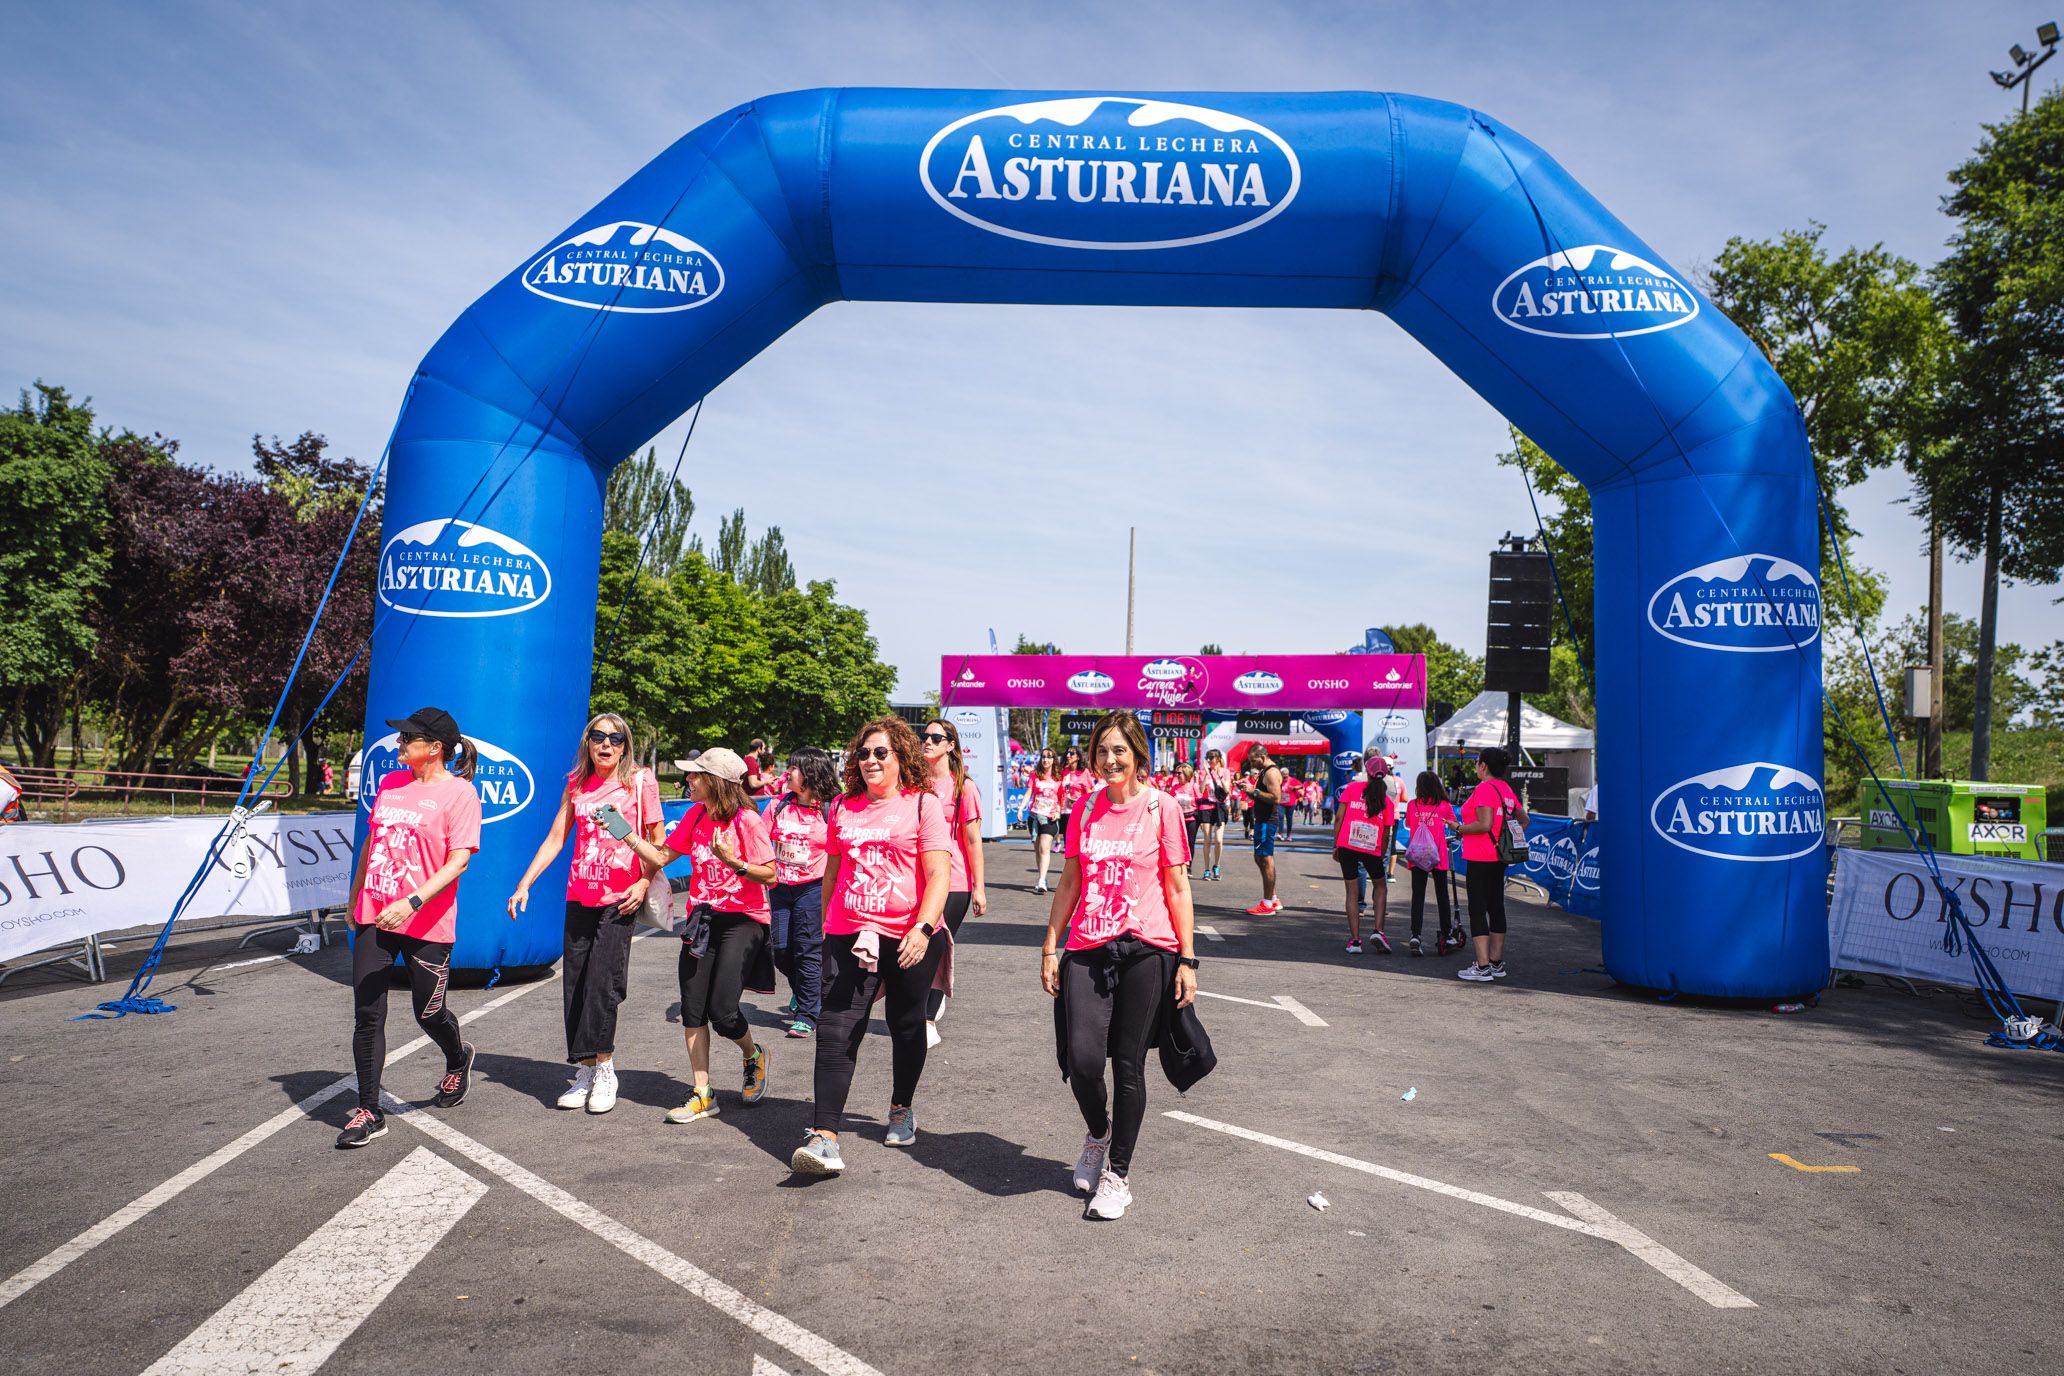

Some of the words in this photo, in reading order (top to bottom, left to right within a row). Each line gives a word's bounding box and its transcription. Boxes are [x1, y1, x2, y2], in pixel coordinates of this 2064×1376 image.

[1008, 133, 1126, 150] CENTRAL
[1139, 136, 1260, 154] LECHERA
[948, 134, 1271, 206] ASTURIANA
[567, 250, 628, 260] CENTRAL
[531, 256, 708, 296] ASTURIANA
[1618, 275, 1677, 290] LECHERA
[1509, 281, 1690, 319] ASTURIANA
[400, 551, 456, 562] CENTRAL
[463, 553, 532, 570] LECHERA
[381, 554, 536, 600] ASTURIANA
[1696, 588, 1766, 599] CENTRAL
[1772, 588, 1816, 600] LECHERA
[1662, 591, 1819, 629] ASTURIANA
[951, 680, 986, 689] Santander
[1007, 679, 1045, 689] OYSHO
[1070, 678, 1112, 689] ASTURIANA
[1137, 678, 1175, 691] Carrera
[1237, 680, 1280, 689] ASTURIANA
[1308, 679, 1350, 689] OYSHO
[1372, 680, 1413, 690] Santander
[1067, 720, 1096, 730] OYSH
[1244, 719, 1284, 730] OYSHO
[958, 732, 982, 740] YSHO
[1152, 727, 1201, 738] OYSHO
[1376, 735, 1410, 745] OYSHO
[1700, 796, 1770, 806] CENTRAL
[1776, 795, 1820, 806] LECHERA
[374, 805, 423, 827] CARRERA
[1666, 797, 1823, 835] ASTURIANA
[1871, 811, 1899, 828] AXOR
[390, 827, 410, 850] DE
[840, 826, 891, 841] CARRERA
[1971, 824, 2025, 840] AXOR
[1080, 837, 1134, 857] CARRERA
[866, 845, 884, 866] DE
[578, 862, 610, 881] MUJER
[1104, 860, 1122, 886] DE
[843, 893, 887, 913] MUJER
